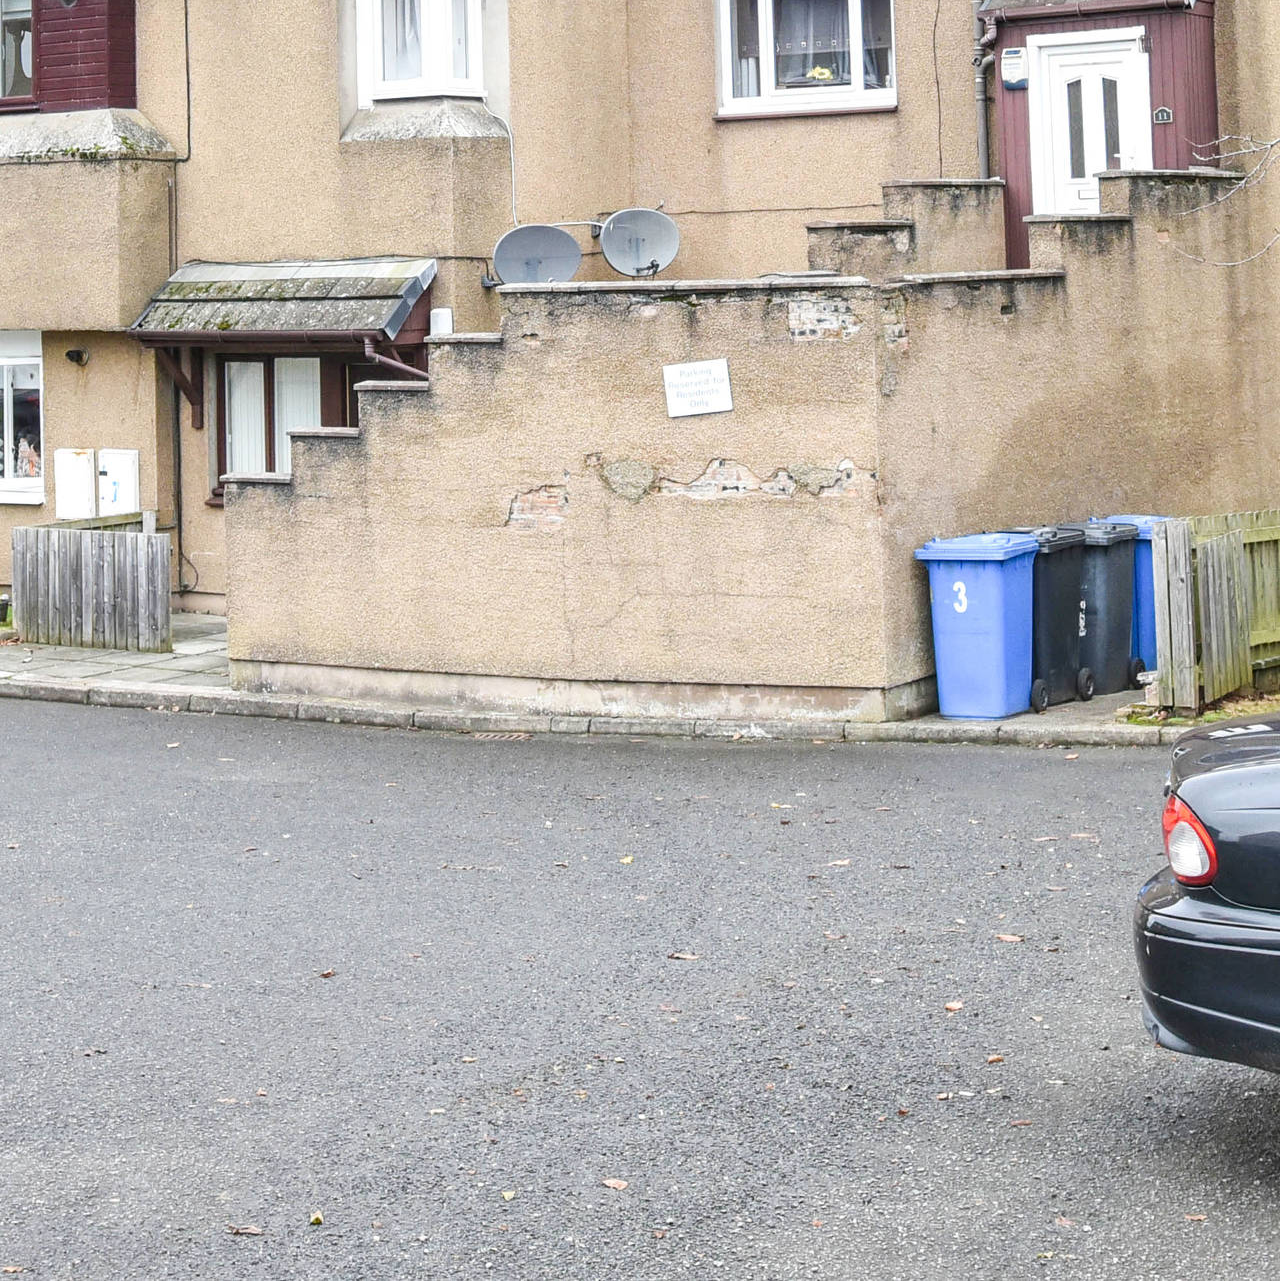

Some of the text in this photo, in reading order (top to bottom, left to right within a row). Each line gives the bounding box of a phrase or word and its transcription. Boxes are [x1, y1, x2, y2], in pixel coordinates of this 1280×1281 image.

[679, 368, 712, 378] Parking
[689, 398, 710, 408] Only
[952, 581, 968, 614] 3
